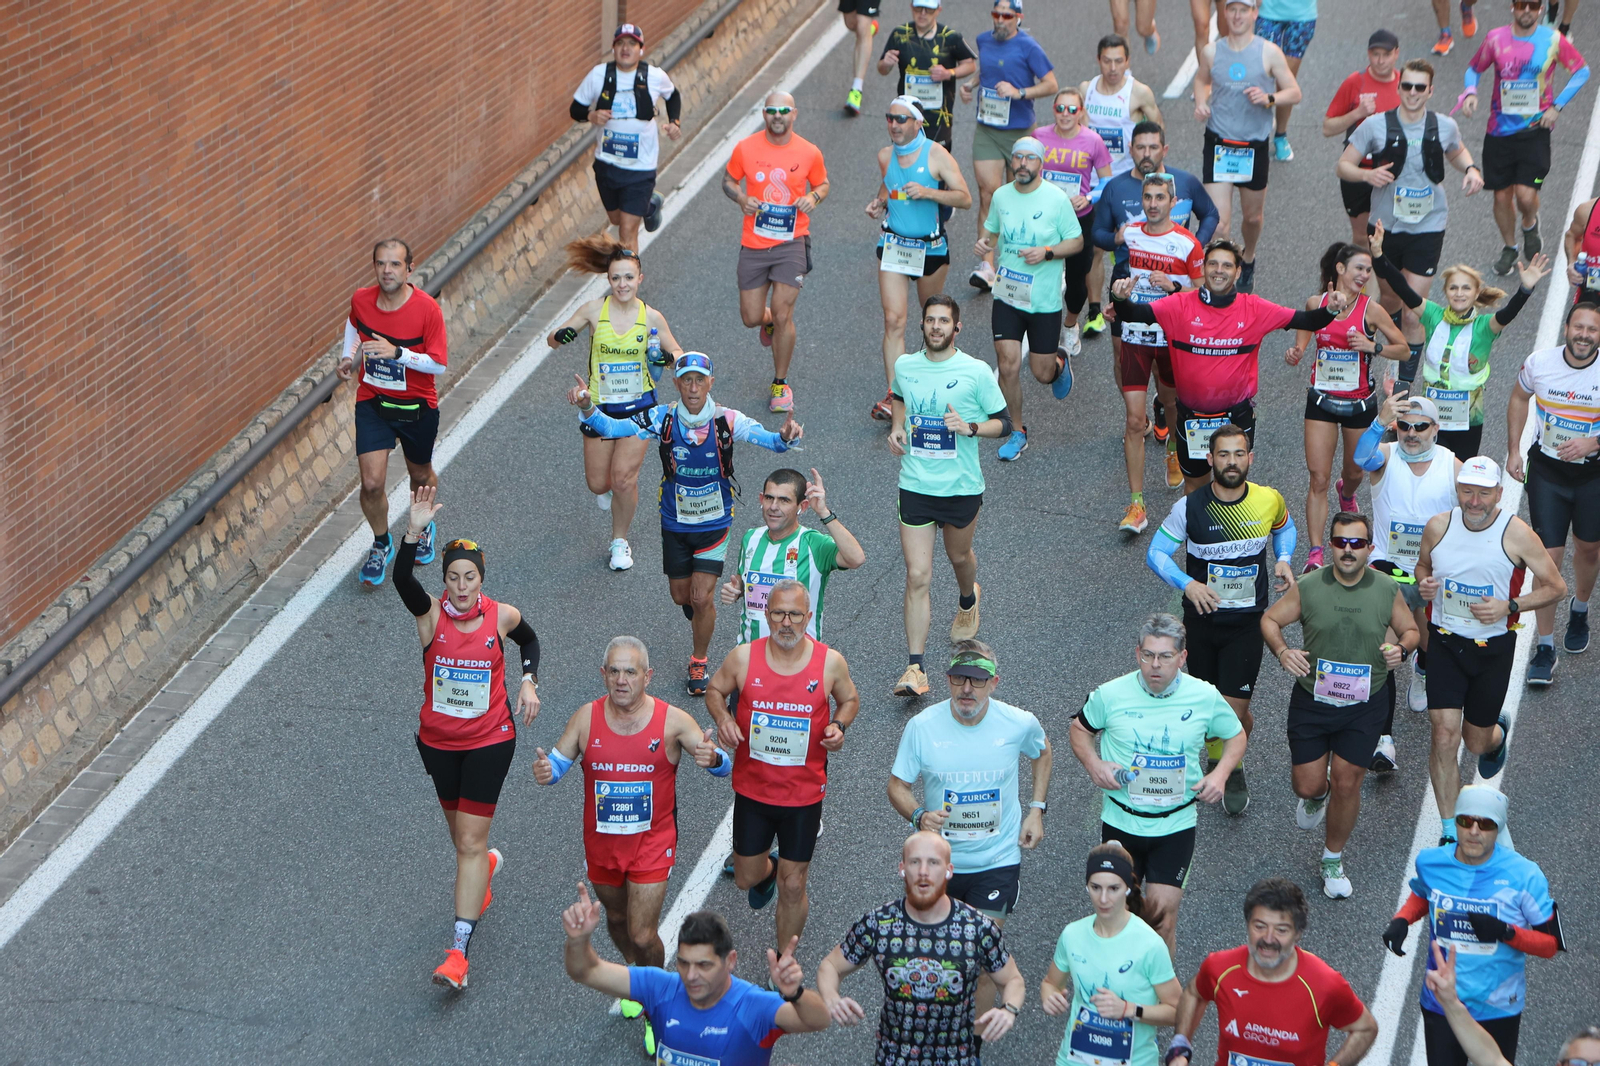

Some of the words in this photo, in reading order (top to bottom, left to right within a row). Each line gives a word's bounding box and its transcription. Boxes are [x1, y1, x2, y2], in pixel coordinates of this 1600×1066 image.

[1086, 103, 1122, 118] PORTUGAL
[613, 132, 637, 141] ZURICH
[1098, 128, 1119, 136] ZURICH
[1053, 173, 1076, 182] ZURICH
[1408, 189, 1430, 198] ZURICH
[771, 206, 793, 215] ZURICH
[899, 240, 921, 249] ZURICH
[1007, 271, 1030, 283] ZURICH
[1189, 334, 1207, 346] Los
[1209, 335, 1244, 347] Lentos
[1191, 346, 1205, 355] CLUB
[1329, 353, 1353, 361] ZURICH
[612, 364, 638, 373] ZURICH
[1439, 391, 1464, 400] ZURICH
[1547, 388, 1593, 402] IMPREXIONA
[1559, 419, 1585, 431] ZURICH
[675, 463, 720, 477] Canarias
[689, 486, 715, 498] ZURICH
[680, 507, 699, 515] MIGUEL
[699, 505, 721, 515] MARTEL
[1407, 523, 1423, 534] ZUR
[1396, 547, 1416, 558] JAVIER
[1225, 566, 1253, 577] ZURICH
[762, 576, 783, 585] ZURI
[1222, 581, 1243, 591] 11203
[1460, 585, 1488, 596] ZURICH
[747, 600, 764, 610] EMILIO
[435, 654, 457, 667] SAN
[457, 658, 492, 669] PEDRO
[1335, 665, 1364, 676] ZURICH
[452, 671, 484, 682] ZURICH
[1332, 681, 1352, 692] 6922
[451, 687, 469, 698] 9234
[1327, 690, 1357, 701] ANGELITO
[446, 697, 475, 709] BEGOFER
[752, 699, 775, 710] SAN
[775, 702, 813, 713] PEDRO
[772, 718, 804, 730] ZURICH
[769, 734, 789, 745] 9204
[591, 762, 614, 772] SAN
[616, 762, 656, 773] PEDRO
[1150, 758, 1181, 769] ZURICH
[937, 770, 1006, 785] VALENCIA
[1148, 776, 1168, 786] 9936
[613, 784, 645, 794] ZURICH
[962, 791, 994, 803] ZURICH
[611, 802, 634, 813] 12891
[607, 812, 624, 823] JOSÉ
[624, 812, 640, 823] LUIS
[961, 810, 981, 820] 9651
[1456, 901, 1492, 915] ZURICH
[1092, 1014, 1127, 1030] ZURICH
[1244, 1022, 1300, 1042] ARMUNDIA
[1242, 1031, 1280, 1047] GROUP
